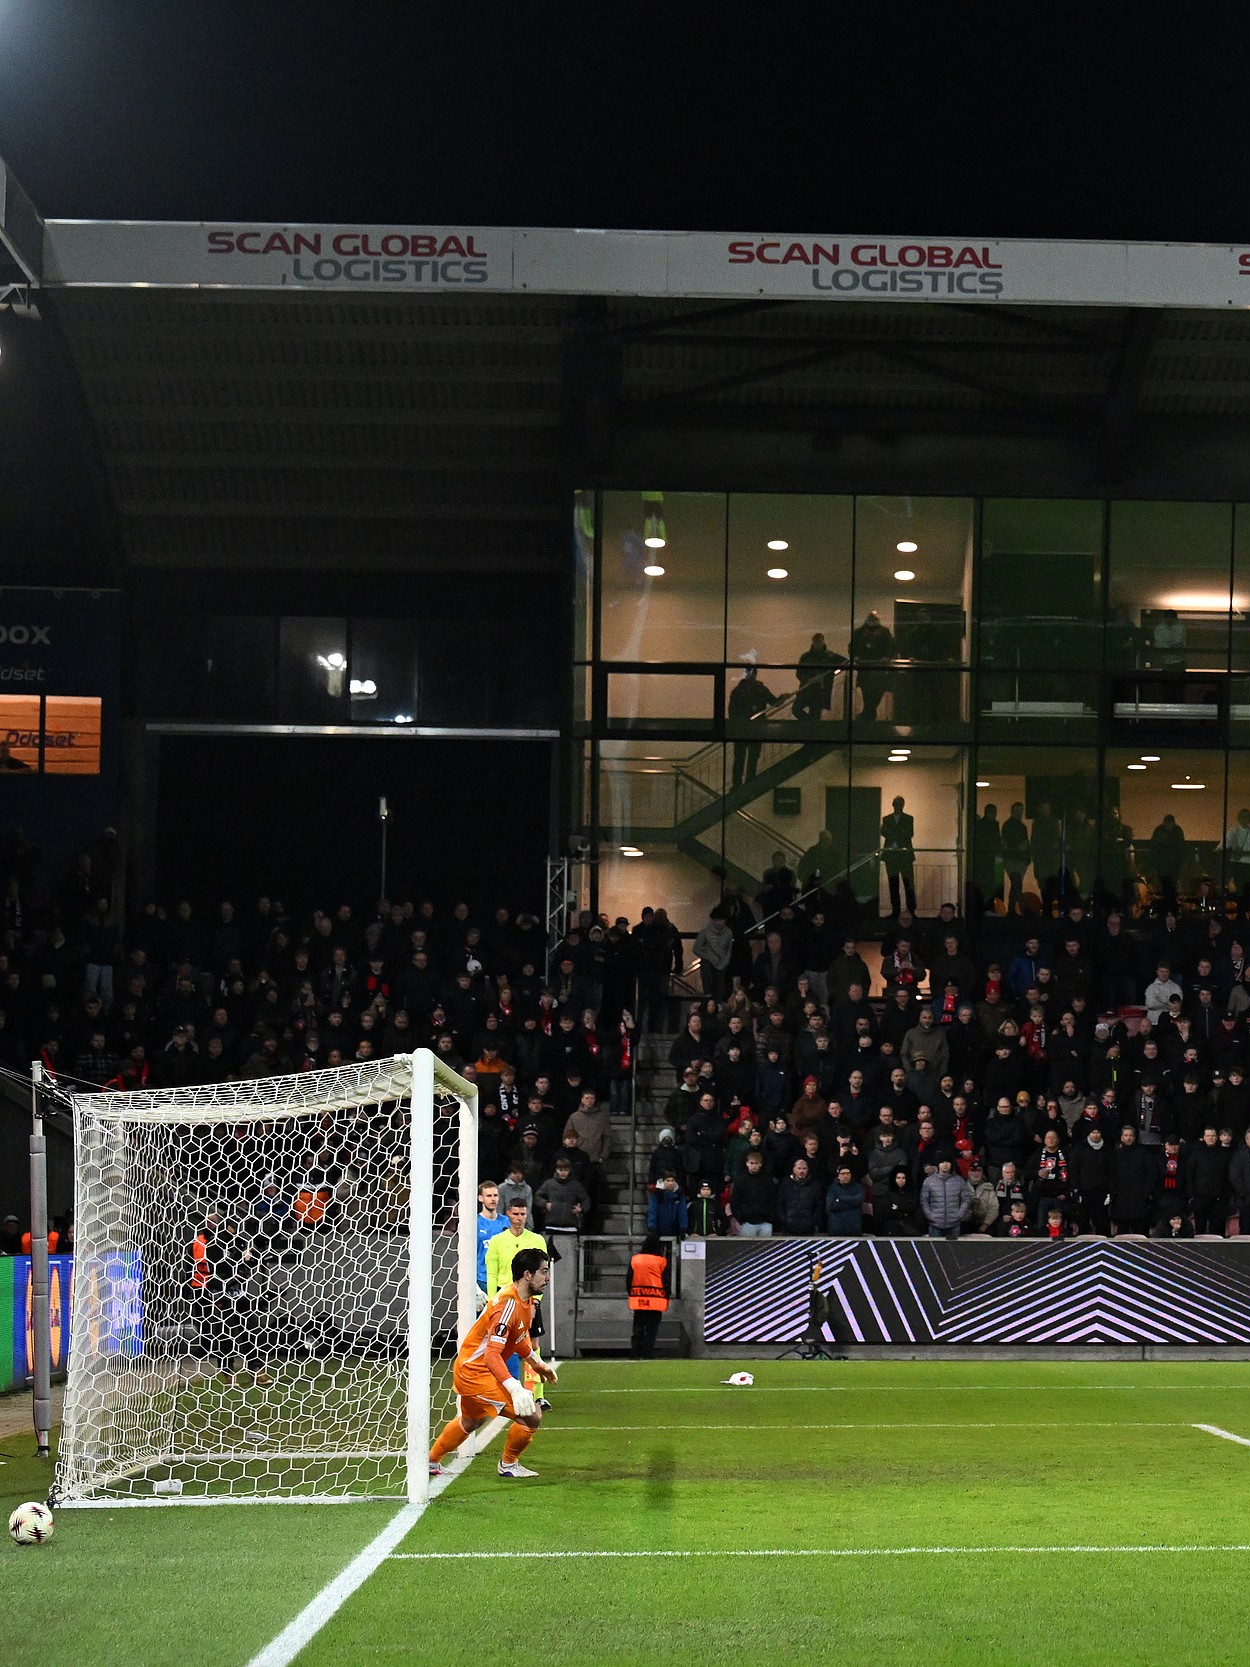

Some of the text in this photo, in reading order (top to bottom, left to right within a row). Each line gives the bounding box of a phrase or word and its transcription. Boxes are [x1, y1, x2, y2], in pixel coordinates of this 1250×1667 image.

[208, 231, 488, 258] SCAN GLOBAL
[728, 242, 1003, 269] SCAN GLOBAL
[293, 258, 488, 284] LOGISTICS
[812, 268, 1003, 294] LOGISTICS
